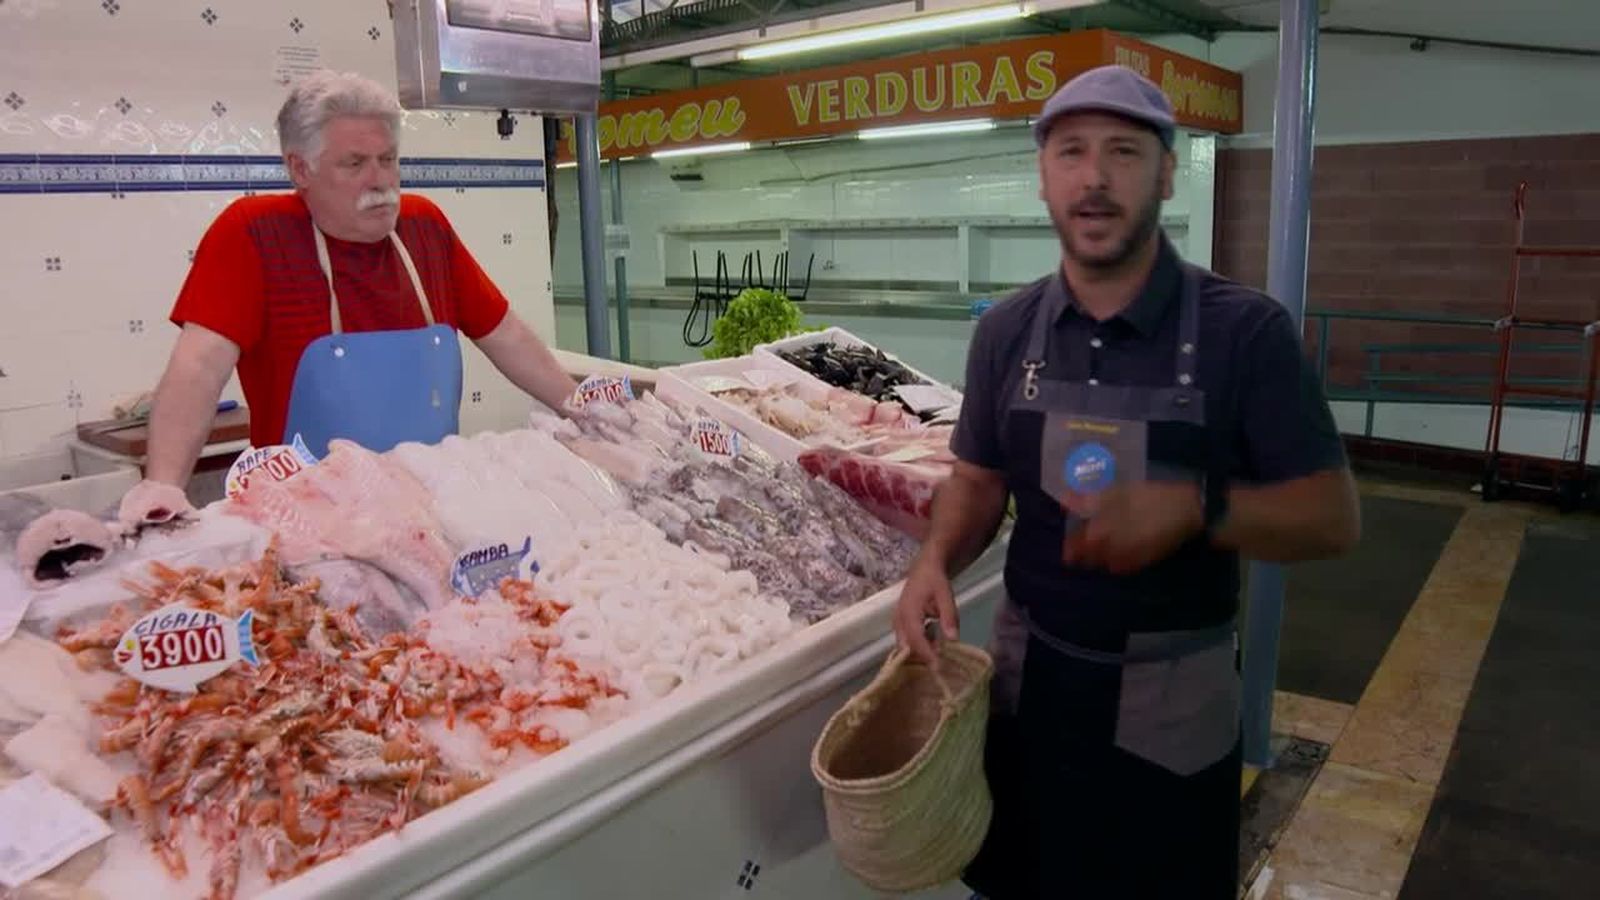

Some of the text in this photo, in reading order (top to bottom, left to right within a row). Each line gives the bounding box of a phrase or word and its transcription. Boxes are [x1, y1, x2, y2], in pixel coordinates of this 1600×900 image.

[787, 50, 1057, 126] VERDURAS
[562, 97, 746, 152] omeu
[700, 431, 730, 454] 1500
[236, 449, 271, 473] RAPE
[238, 451, 299, 490] 200
[459, 543, 509, 569] GAMBA
[134, 612, 218, 634] CIGALA
[142, 627, 222, 668] 3900
